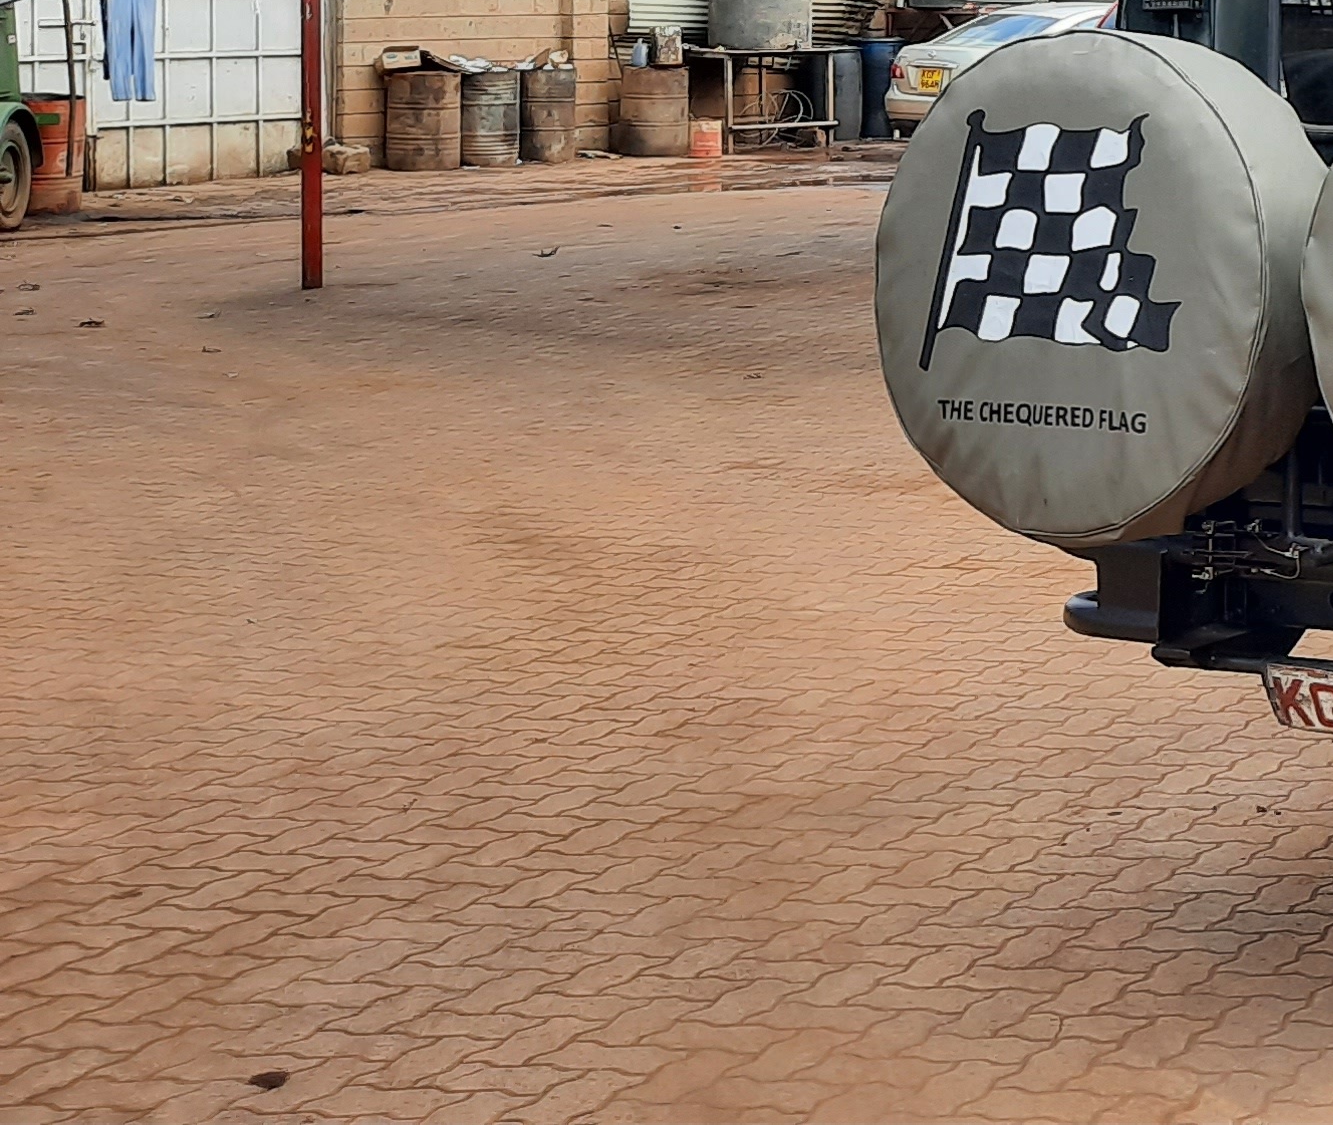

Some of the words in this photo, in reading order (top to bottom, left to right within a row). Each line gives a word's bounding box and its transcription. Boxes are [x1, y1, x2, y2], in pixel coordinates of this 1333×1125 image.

[937, 399, 974, 421] THE
[979, 401, 1094, 428] CHEQUERED
[1098, 409, 1147, 434] FLAG
